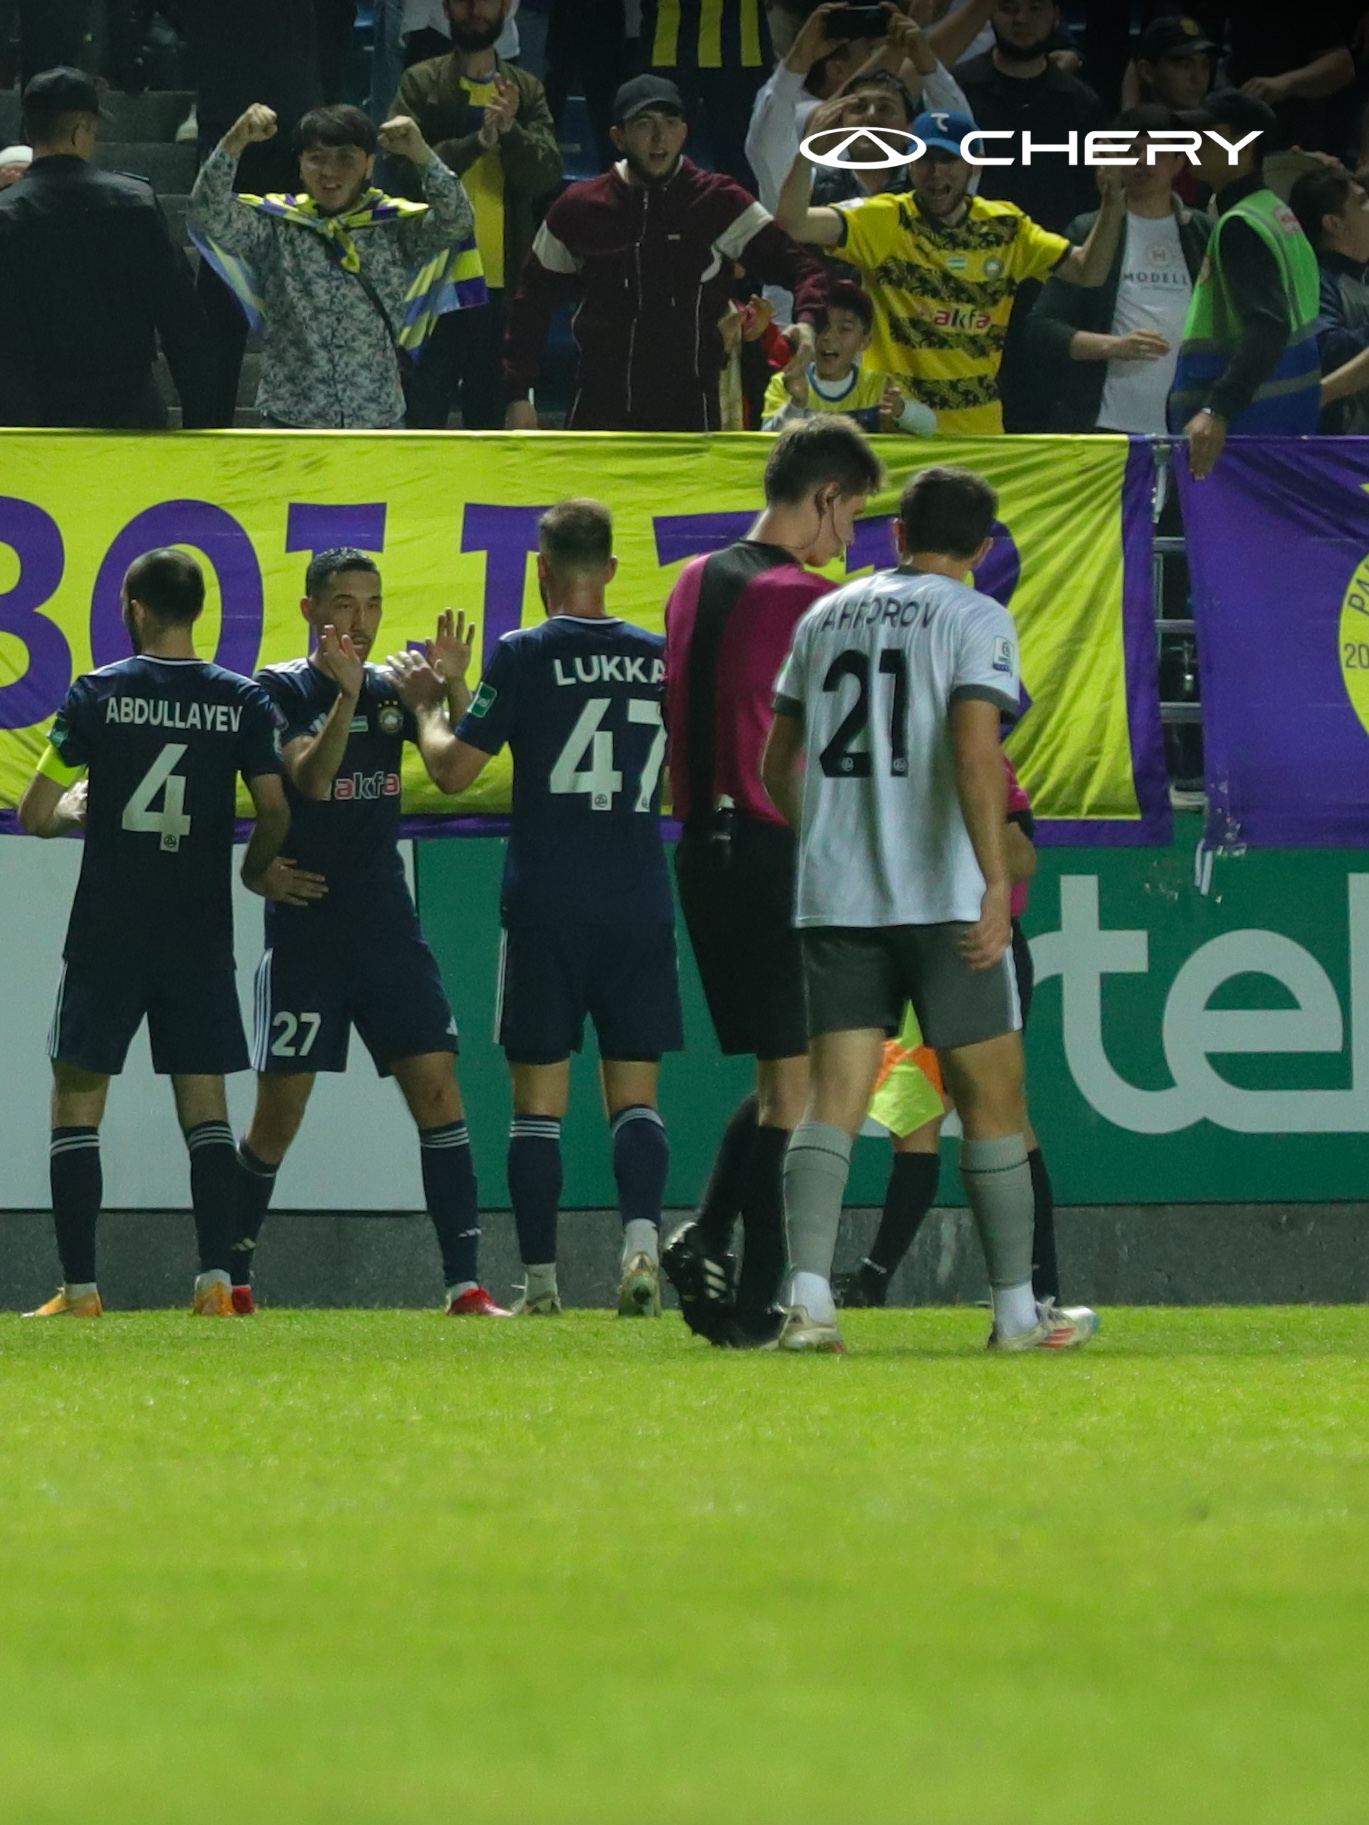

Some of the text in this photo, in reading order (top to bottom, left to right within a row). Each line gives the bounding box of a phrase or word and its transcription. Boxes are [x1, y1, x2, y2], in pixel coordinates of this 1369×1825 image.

[933, 307, 991, 330] akfa
[105, 696, 244, 732] ABDULLAYEV
[819, 648, 908, 778] 21
[549, 697, 668, 813] 47
[121, 742, 192, 853] 4
[334, 771, 401, 800] akfa
[270, 1010, 323, 1057] 27
